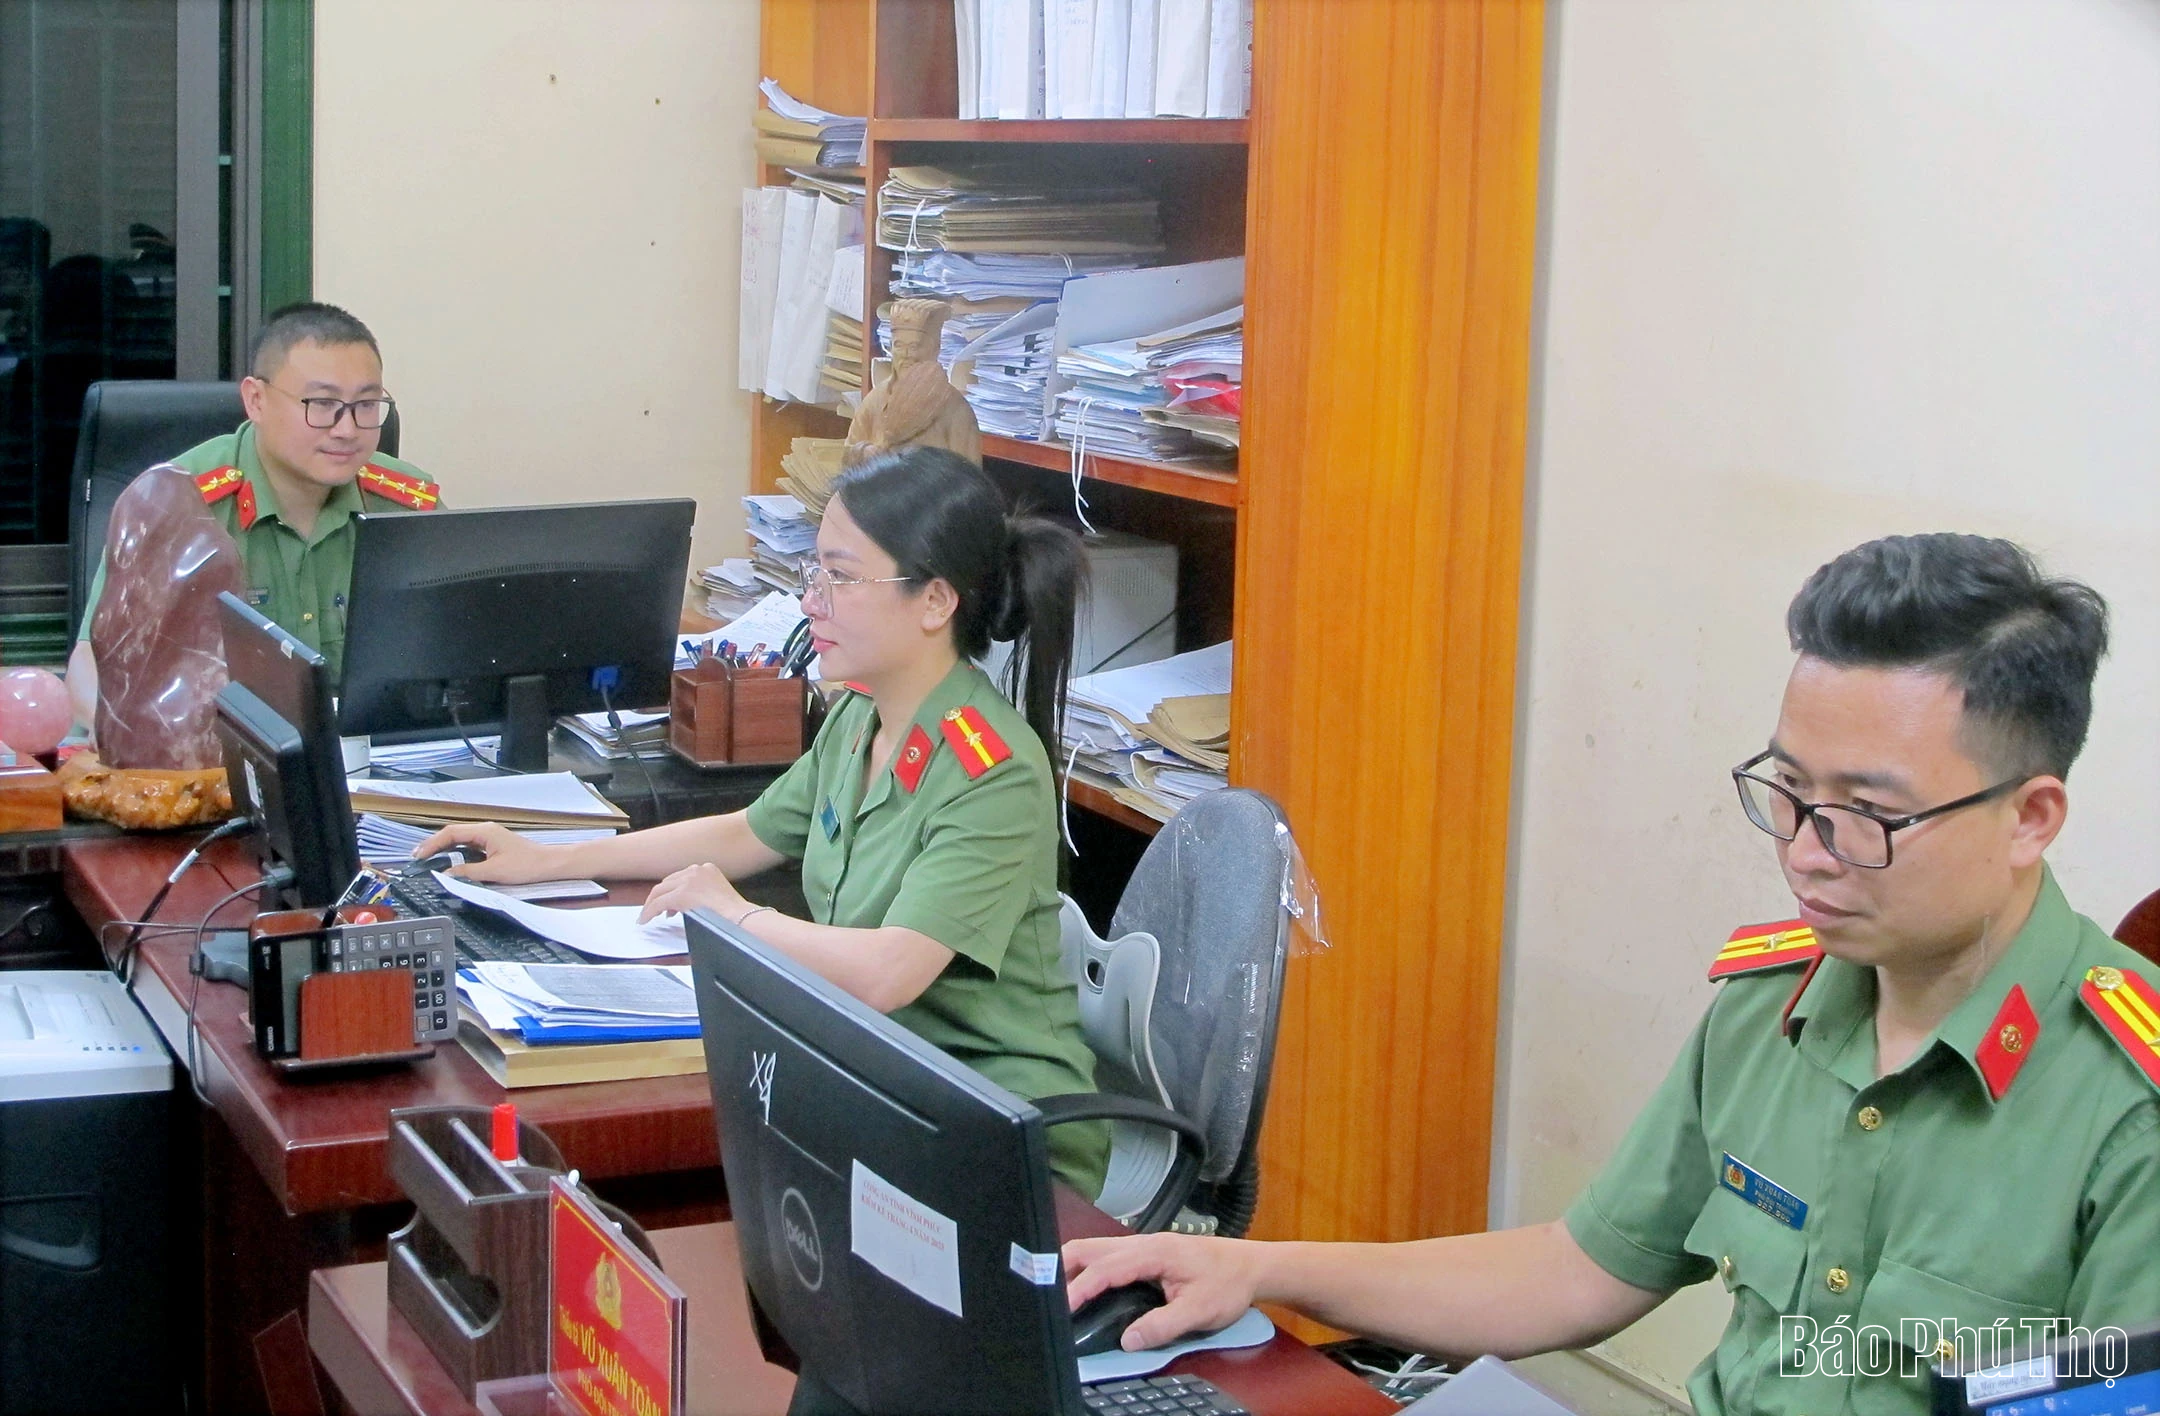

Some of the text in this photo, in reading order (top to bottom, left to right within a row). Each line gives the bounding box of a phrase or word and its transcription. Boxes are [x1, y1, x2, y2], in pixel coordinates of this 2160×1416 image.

[267, 1026, 275, 1051] CASIO
[785, 1217, 818, 1262] DELL
[581, 1323, 596, 1364] VŨ
[598, 1342, 628, 1401] XUÂN
